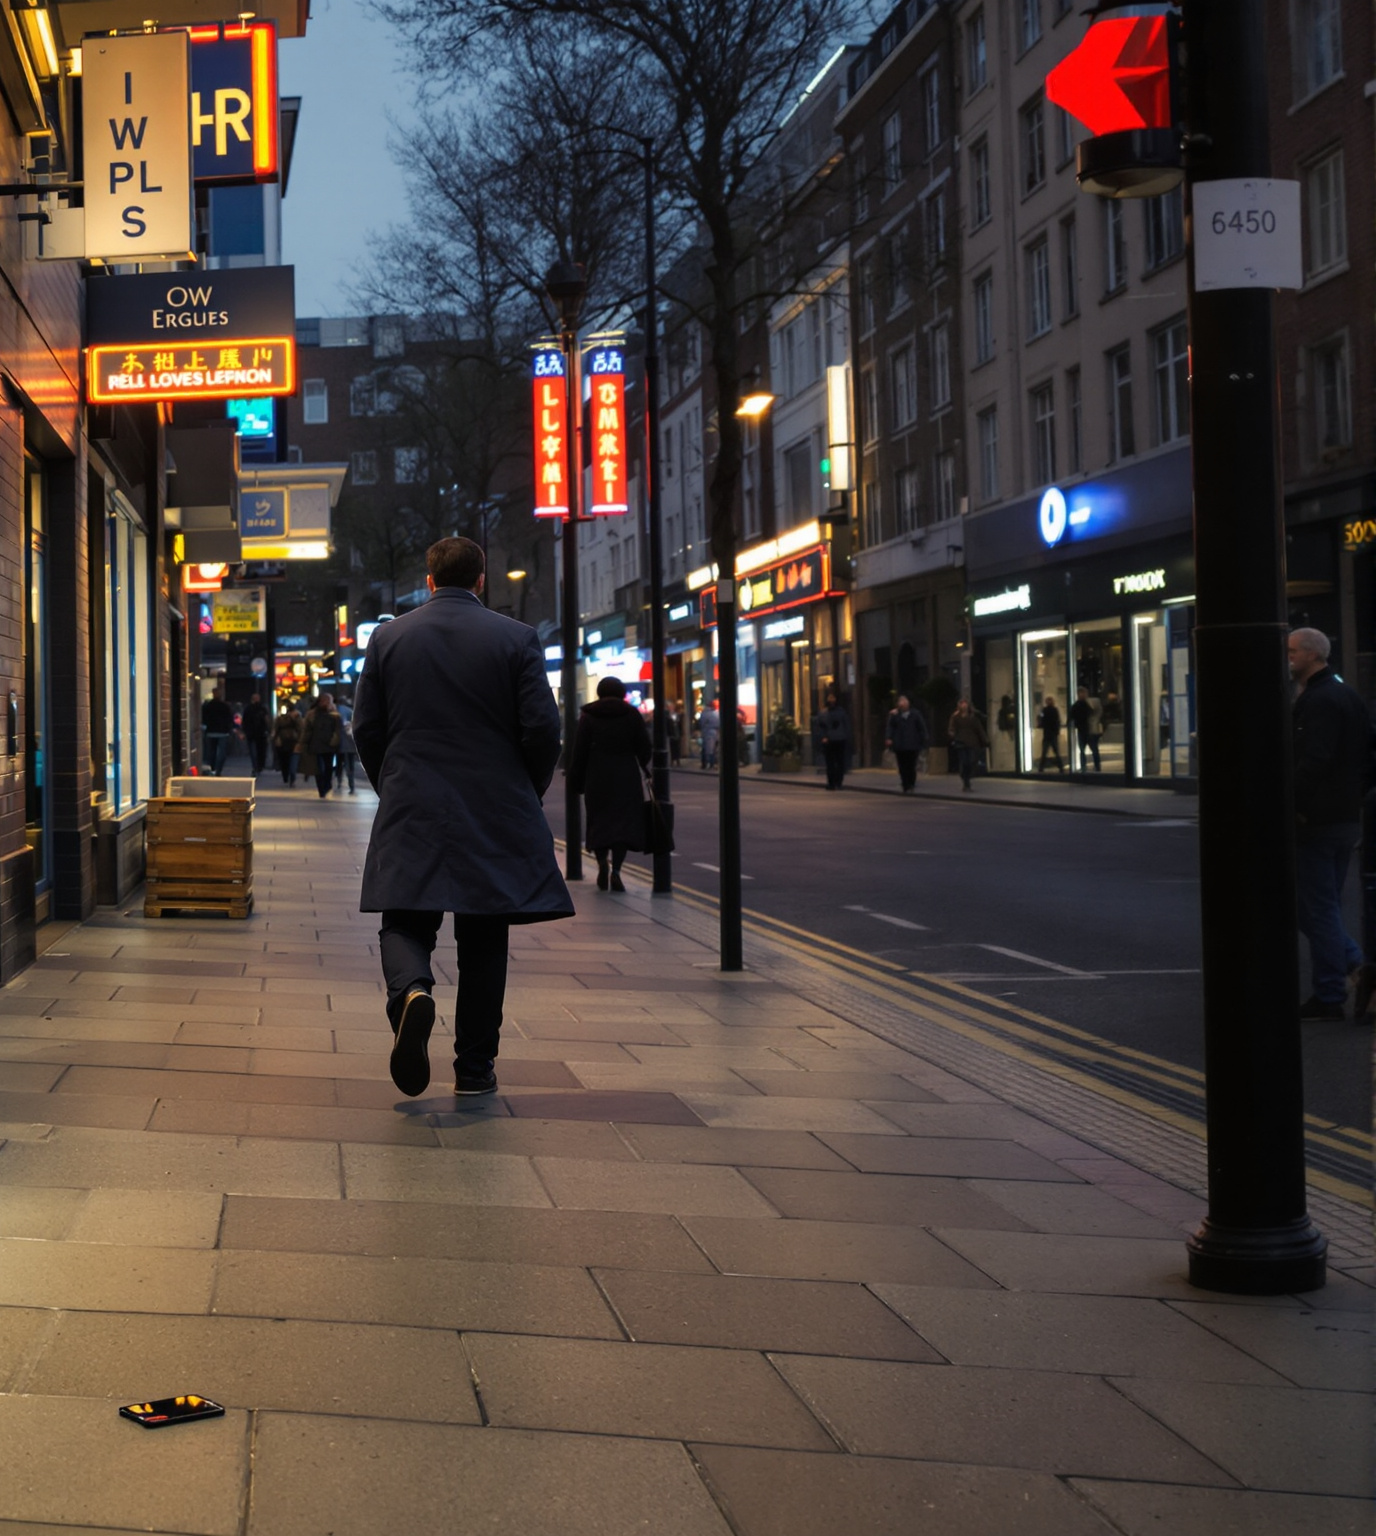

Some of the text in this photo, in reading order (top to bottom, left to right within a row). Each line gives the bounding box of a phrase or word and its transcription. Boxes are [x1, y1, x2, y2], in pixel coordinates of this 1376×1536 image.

[1212, 209, 1276, 235] 6450
[166, 285, 213, 308] OW
[149, 370, 204, 389] LOVES
